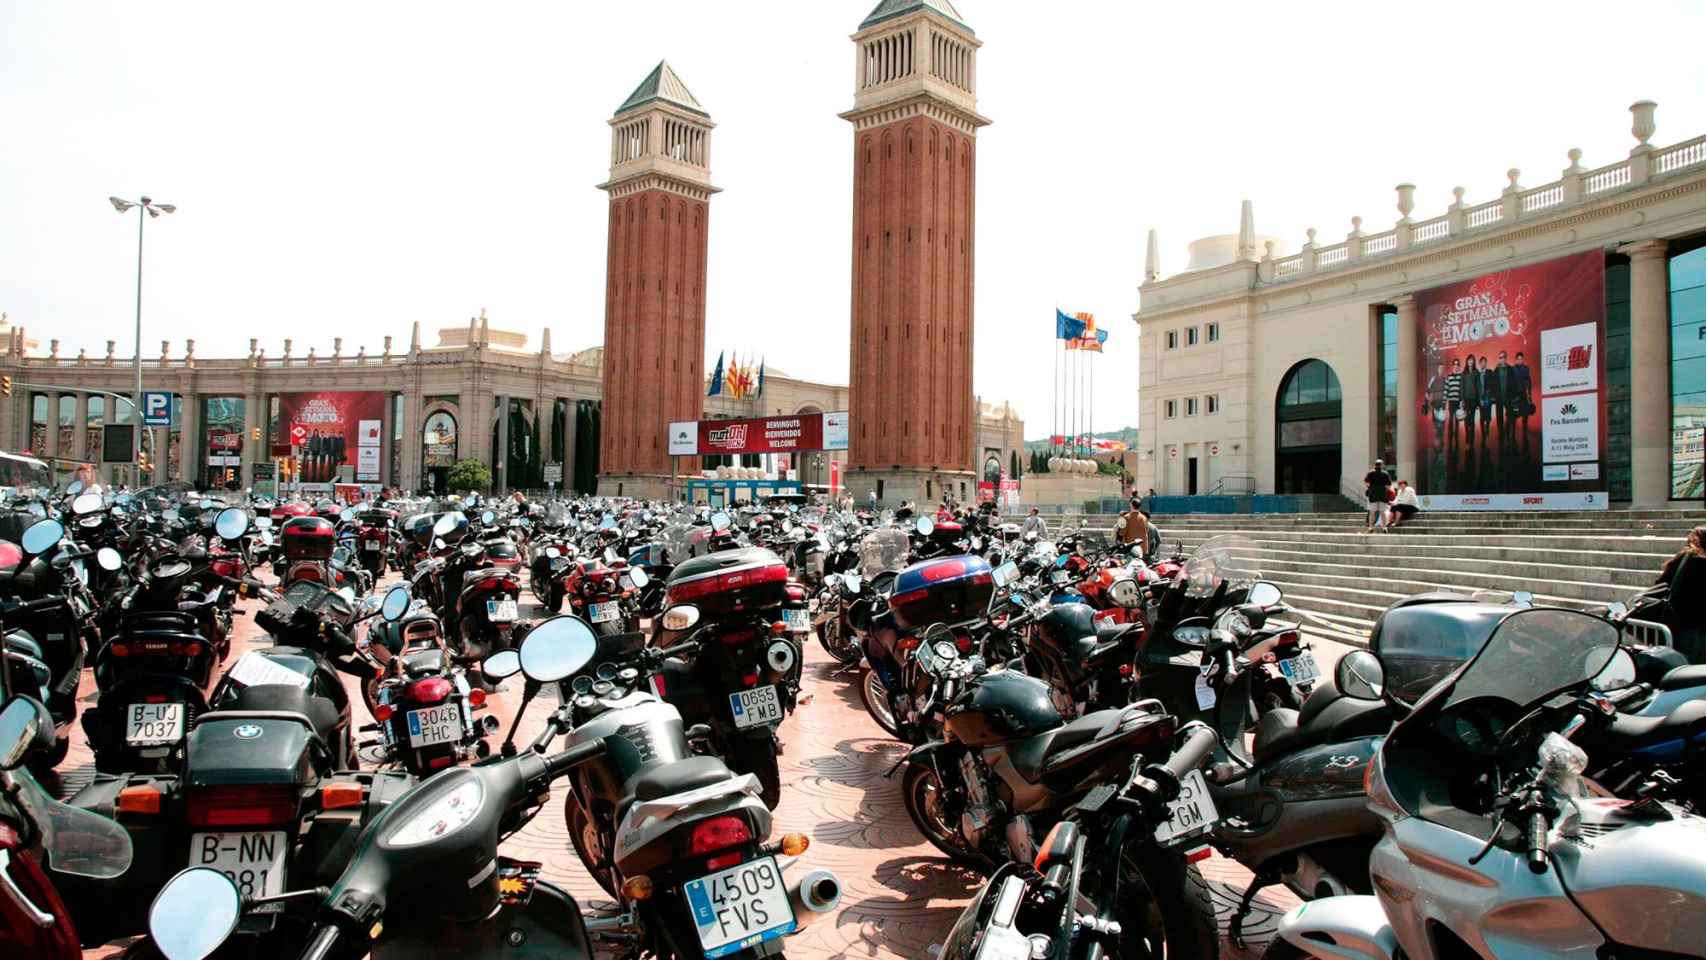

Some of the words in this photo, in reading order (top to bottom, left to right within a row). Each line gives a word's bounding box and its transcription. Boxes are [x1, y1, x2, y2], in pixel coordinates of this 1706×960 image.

[1455, 292, 1491, 310] GRAN
[1448, 303, 1508, 324] SETMANA
[1452, 317, 1510, 343] MOTO
[147, 394, 167, 416] P
[765, 429, 801, 439] BIENVENIDOS
[769, 439, 797, 448] WELCOME
[741, 687, 775, 707] 0655
[420, 706, 457, 726] 3046
[747, 703, 777, 721] FMB
[133, 721, 176, 738] 7037
[422, 725, 450, 743] FHC
[202, 834, 275, 864] B-NN
[712, 864, 775, 905] 4509
[716, 898, 769, 938] FVS
